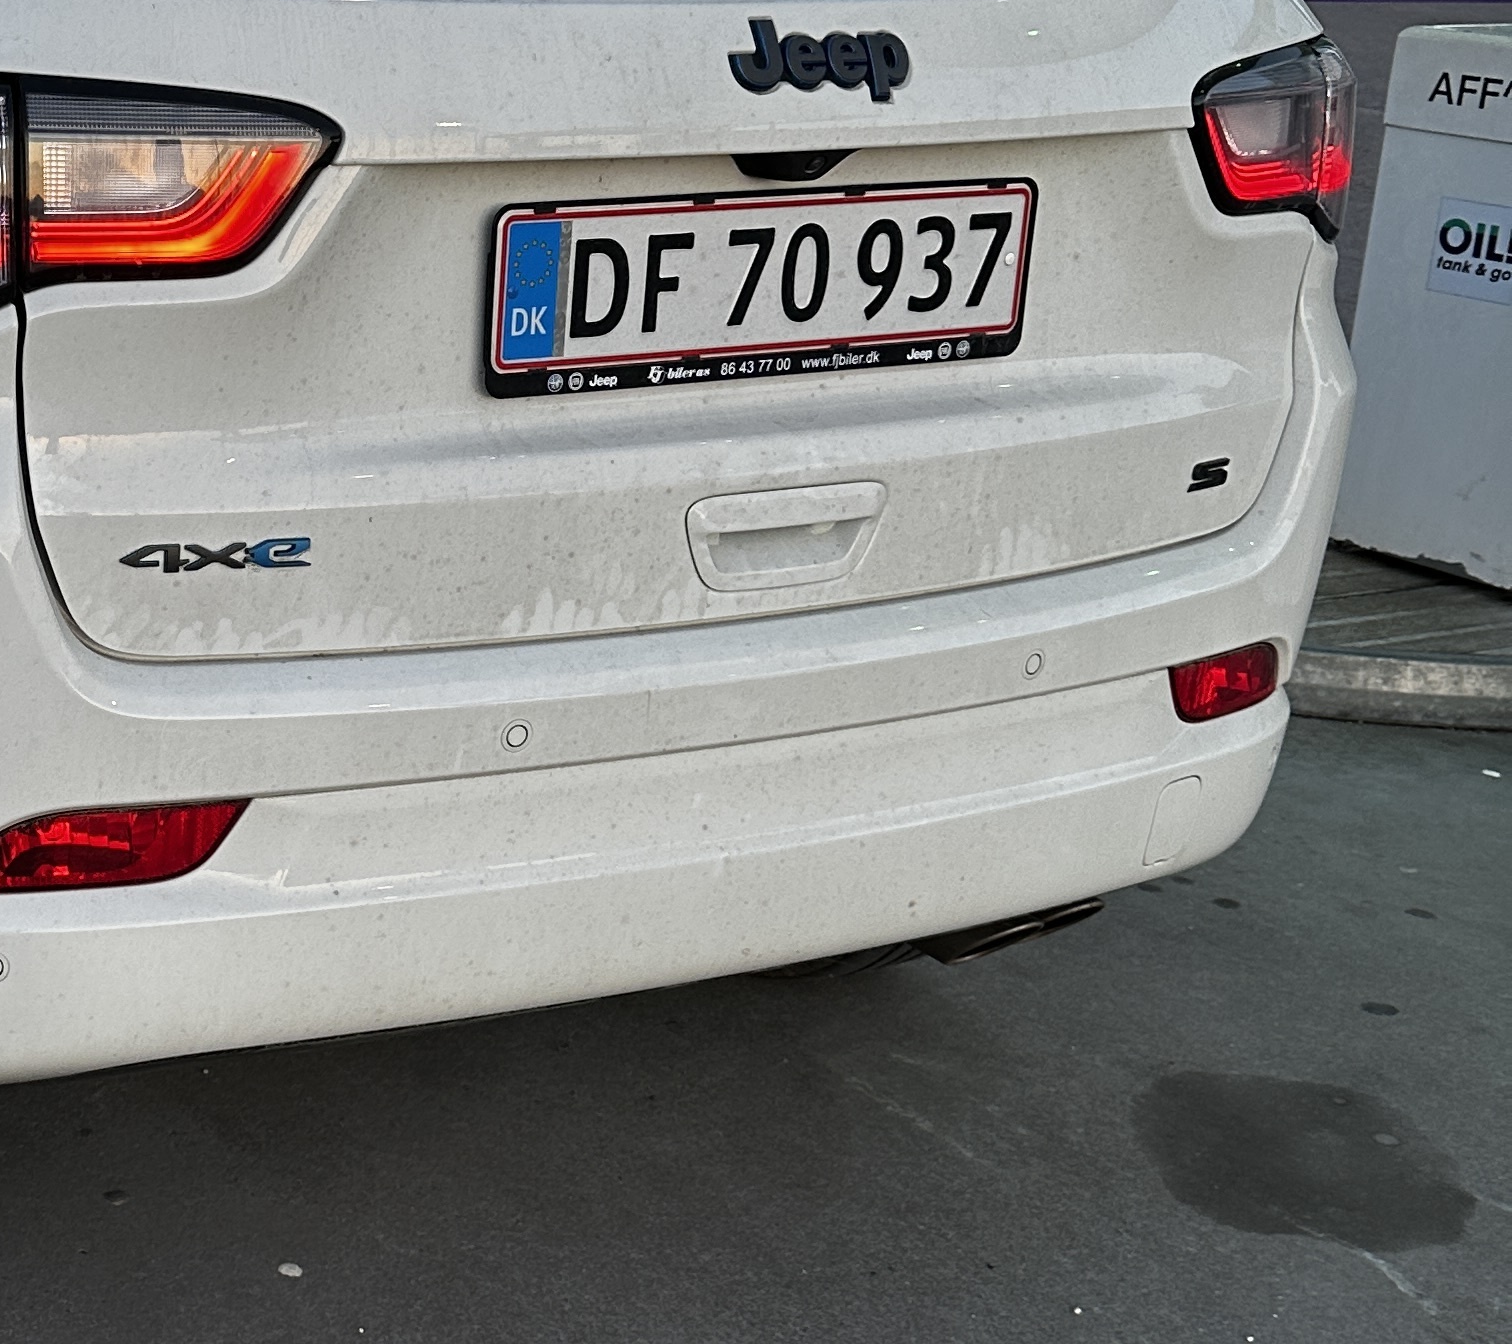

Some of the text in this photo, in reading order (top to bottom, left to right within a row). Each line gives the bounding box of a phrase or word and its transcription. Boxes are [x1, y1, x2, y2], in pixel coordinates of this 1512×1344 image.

[727, 15, 911, 105] Jeep
[568, 210, 1013, 339] DF 70 937
[1436, 256, 1512, 283] tank & go
[510, 305, 548, 337] DK
[589, 373, 619, 388] Jeep
[720, 362, 736, 376] 86
[739, 360, 755, 374] 43
[758, 358, 773, 372] 77
[776, 357, 791, 371] 00
[801, 350, 881, 369] www.fjbiler.dk
[906, 348, 933, 362] Jeep
[1186, 456, 1231, 493] S
